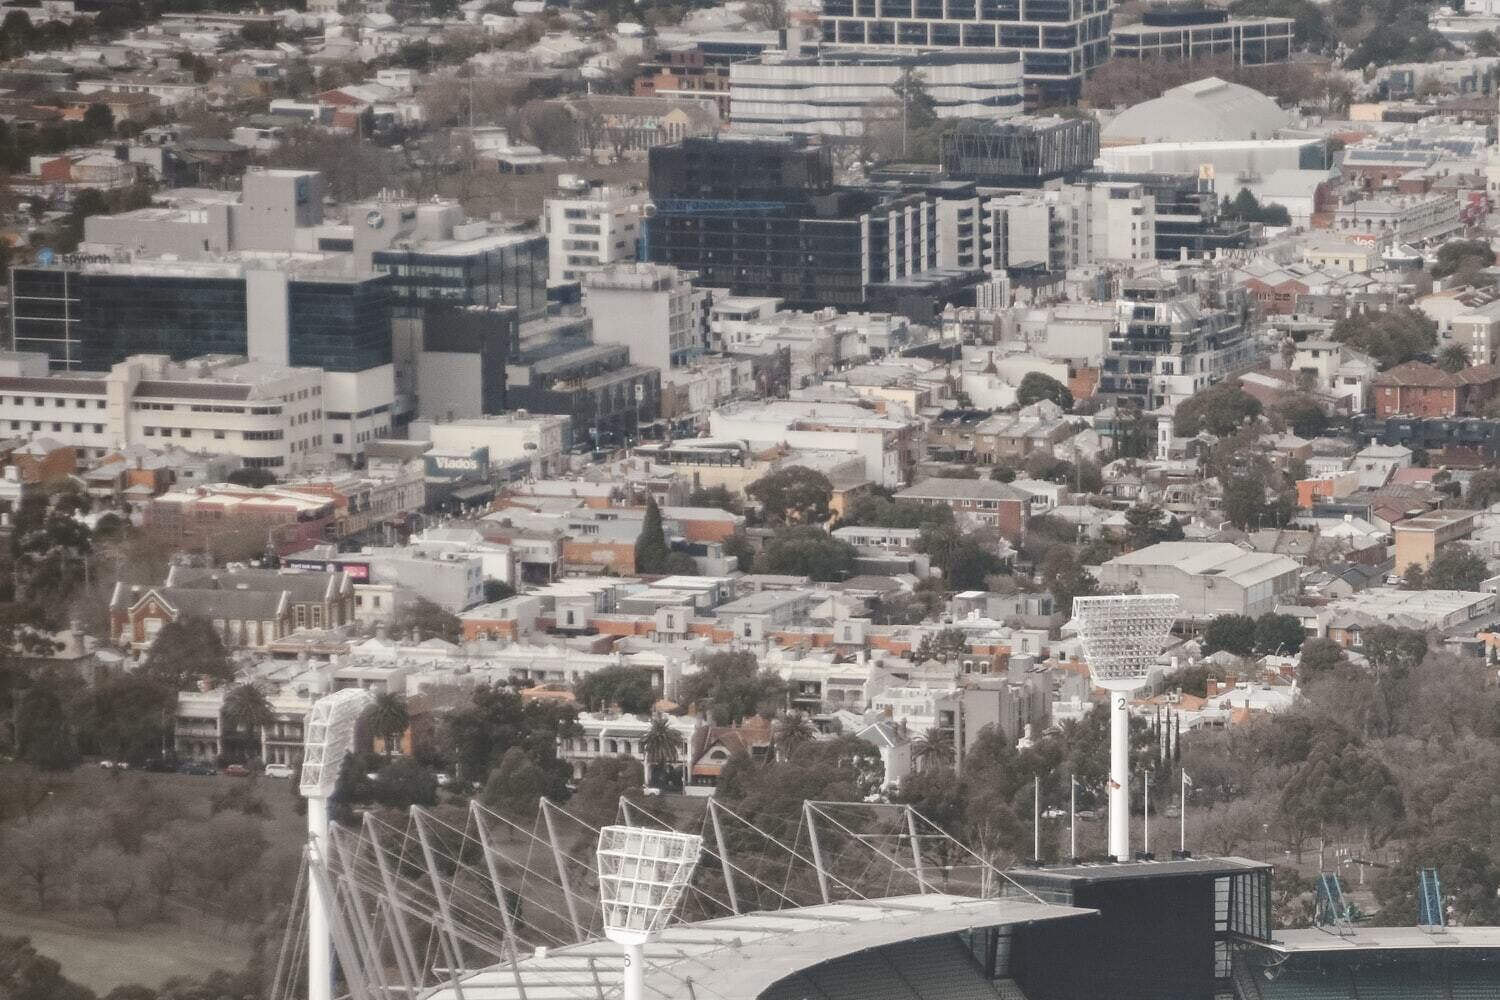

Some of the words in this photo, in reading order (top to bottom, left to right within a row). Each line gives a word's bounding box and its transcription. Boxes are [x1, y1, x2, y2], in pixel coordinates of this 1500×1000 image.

[435, 456, 477, 470] Vlado's
[1117, 697, 1127, 711] 2
[624, 953, 632, 968] 6
